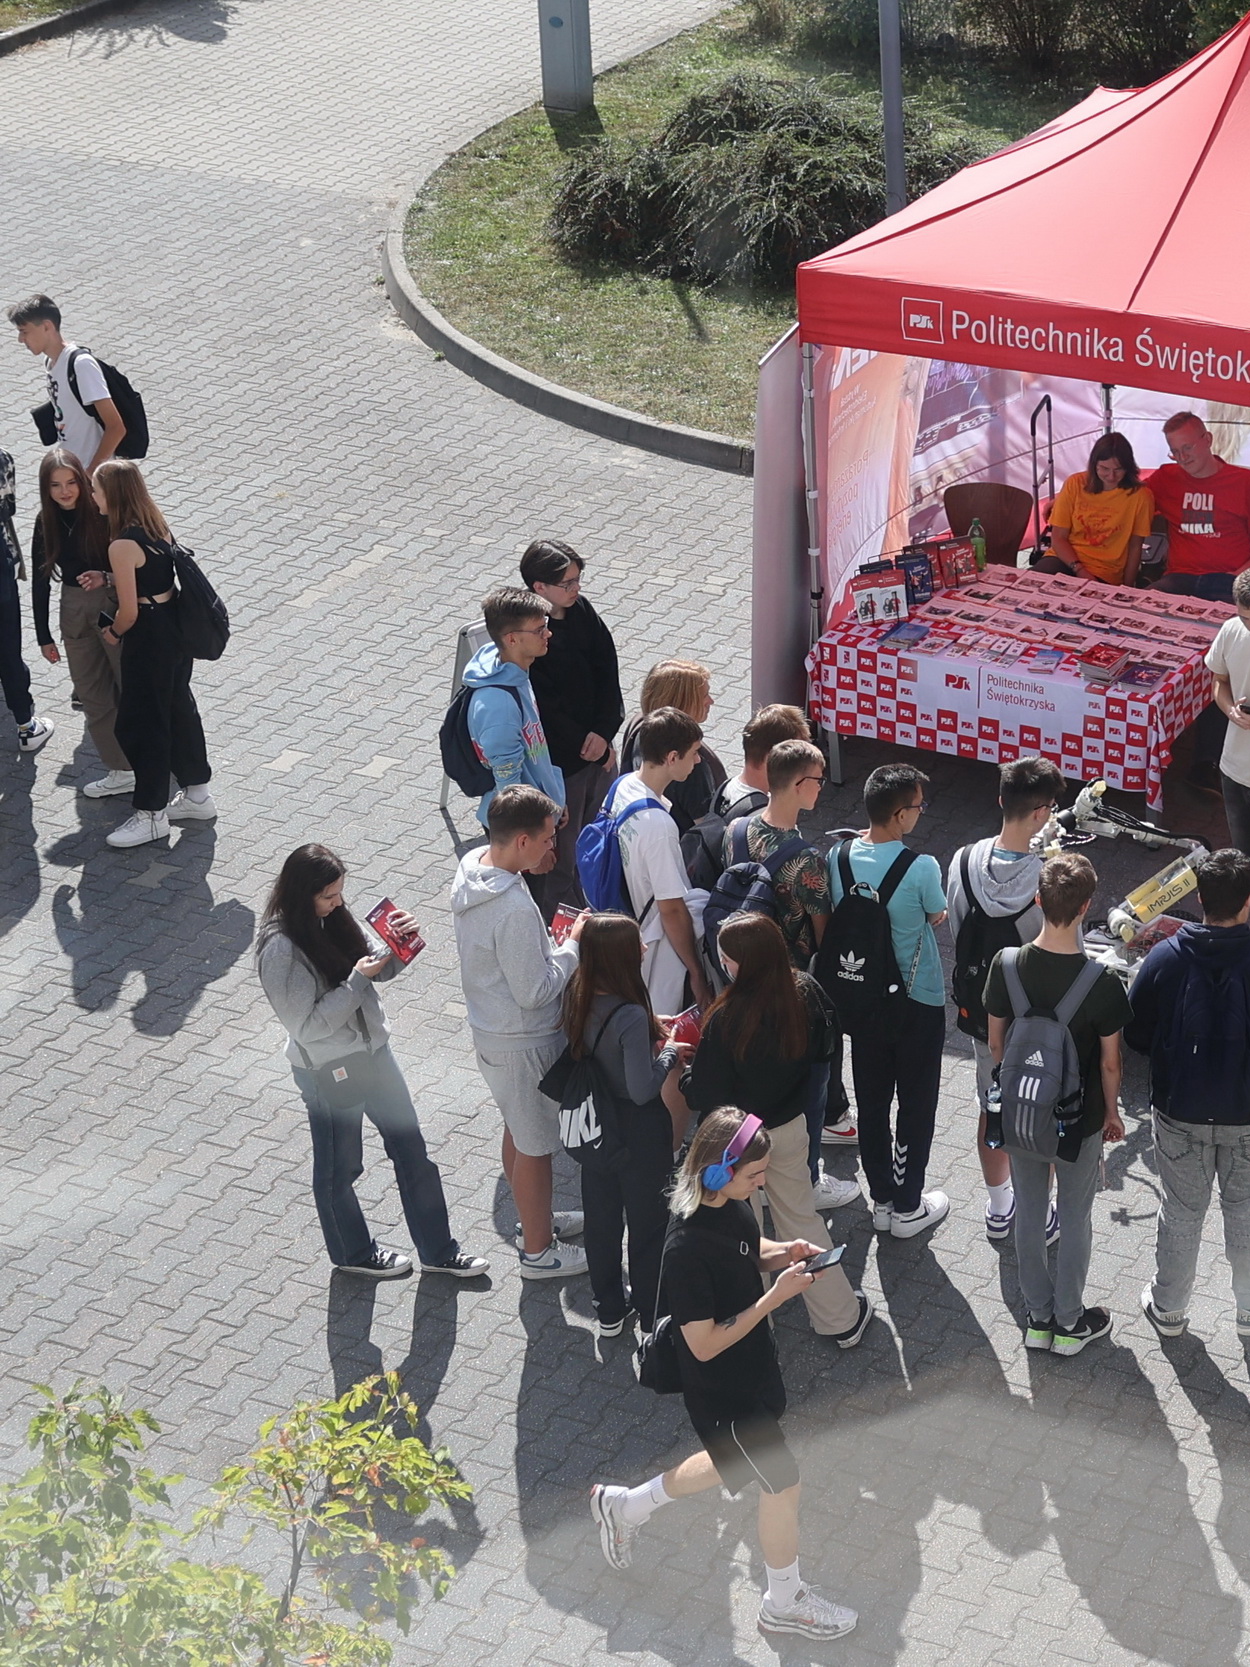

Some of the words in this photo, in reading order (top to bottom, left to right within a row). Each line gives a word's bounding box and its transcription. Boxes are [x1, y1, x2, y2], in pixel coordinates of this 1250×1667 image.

[951, 310, 1124, 362] Politechnika
[1183, 492, 1214, 511] POLI
[987, 674, 1044, 695] Politechnika
[987, 688, 1055, 712] Świętokrzyska
[837, 970, 864, 982] adidas
